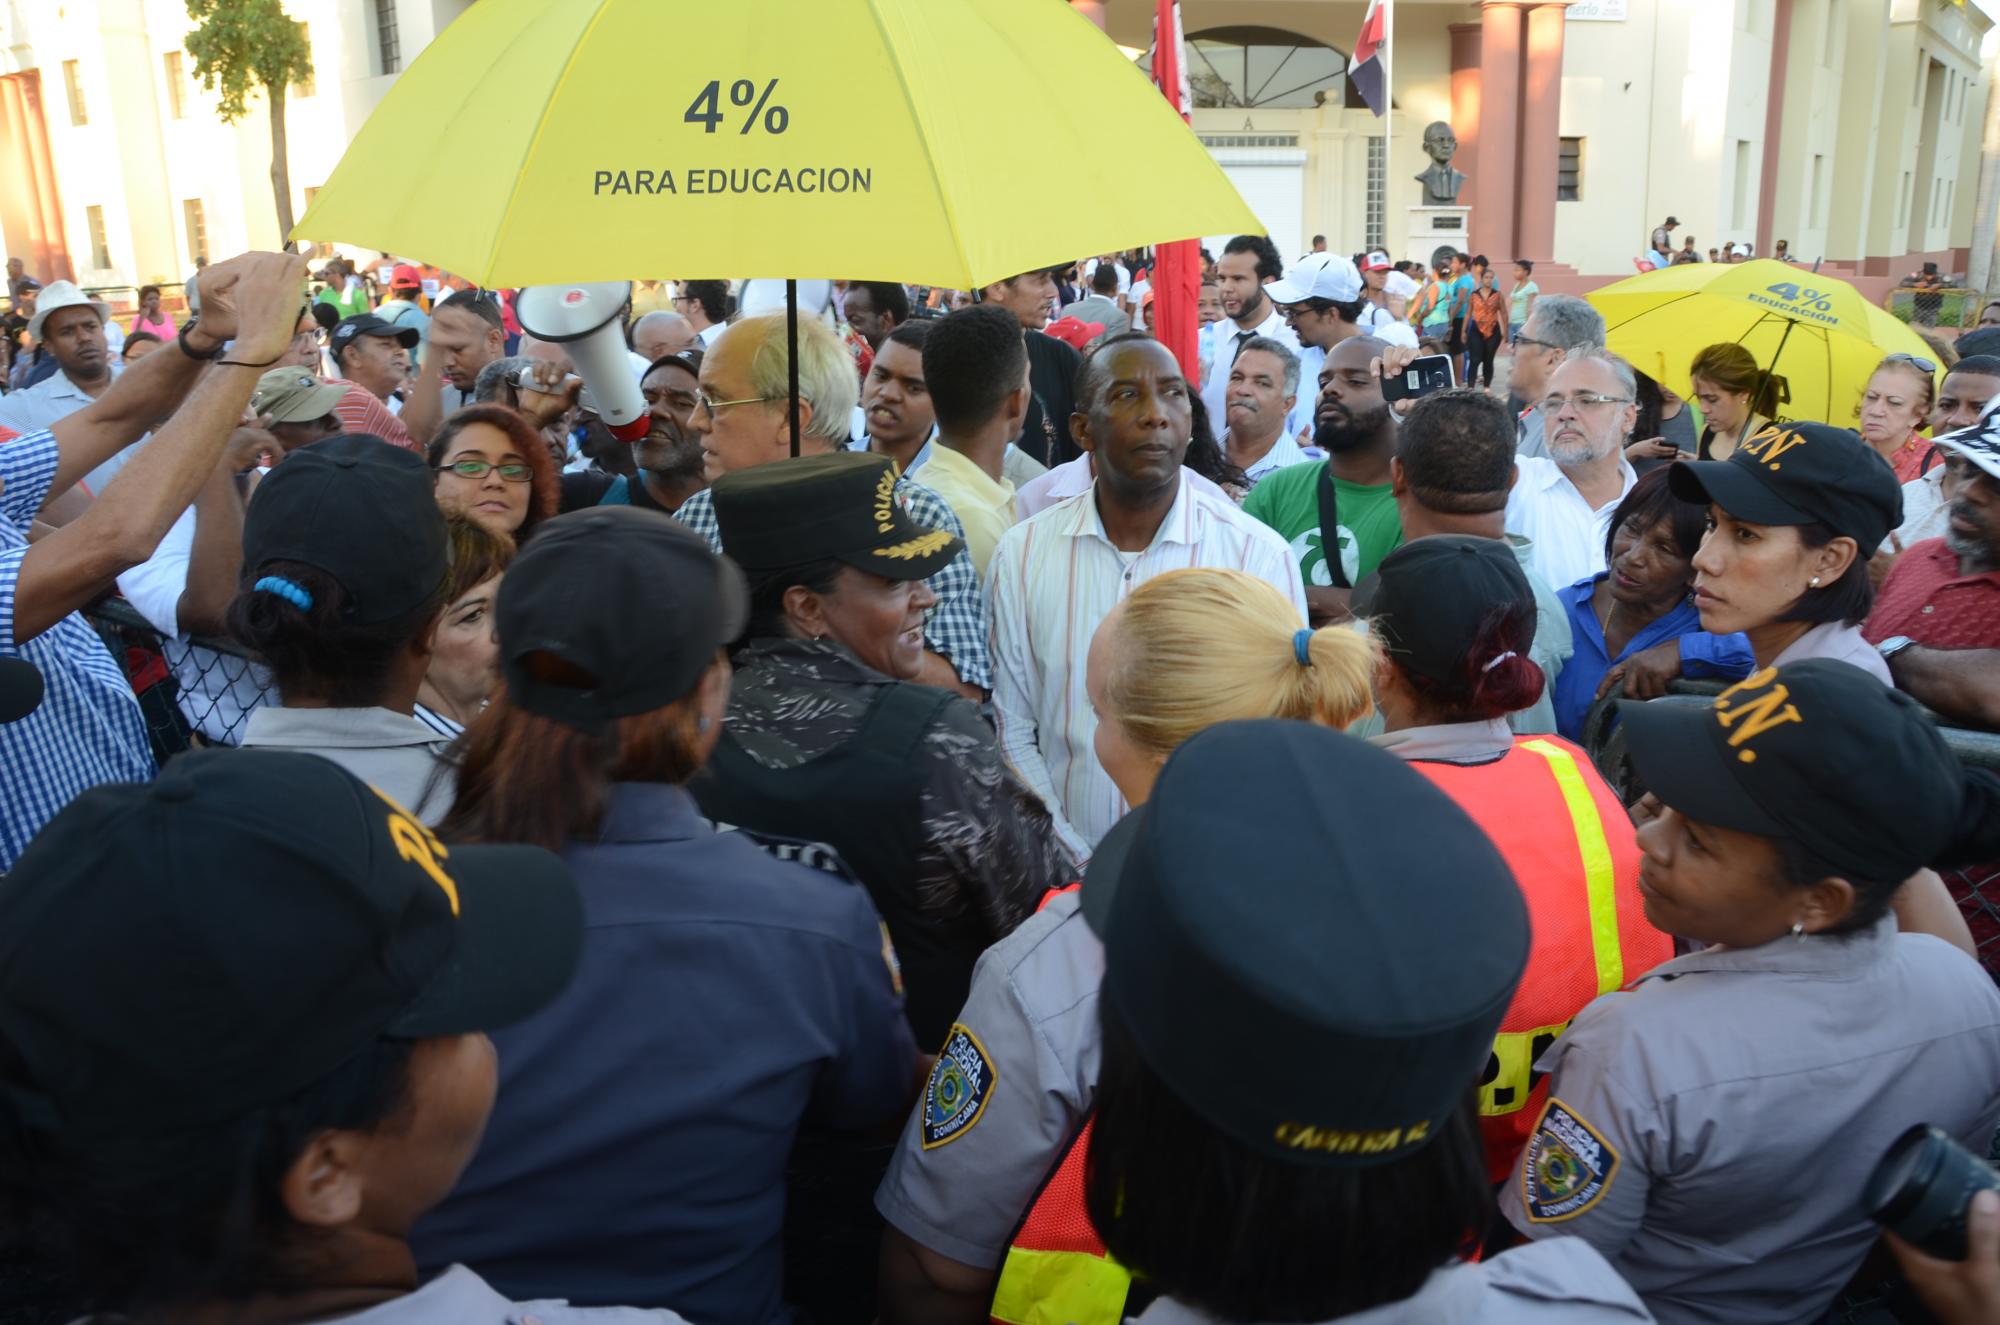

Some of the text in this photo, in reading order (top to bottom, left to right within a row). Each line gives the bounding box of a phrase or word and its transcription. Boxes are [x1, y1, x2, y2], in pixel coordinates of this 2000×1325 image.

[684, 78, 789, 135] 4%
[594, 167, 871, 195] PARA EDUCACION
[1766, 282, 1832, 312] 4%
[956, 1033, 983, 1074] POLICIA
[933, 1099, 979, 1139] DOMINICANA
